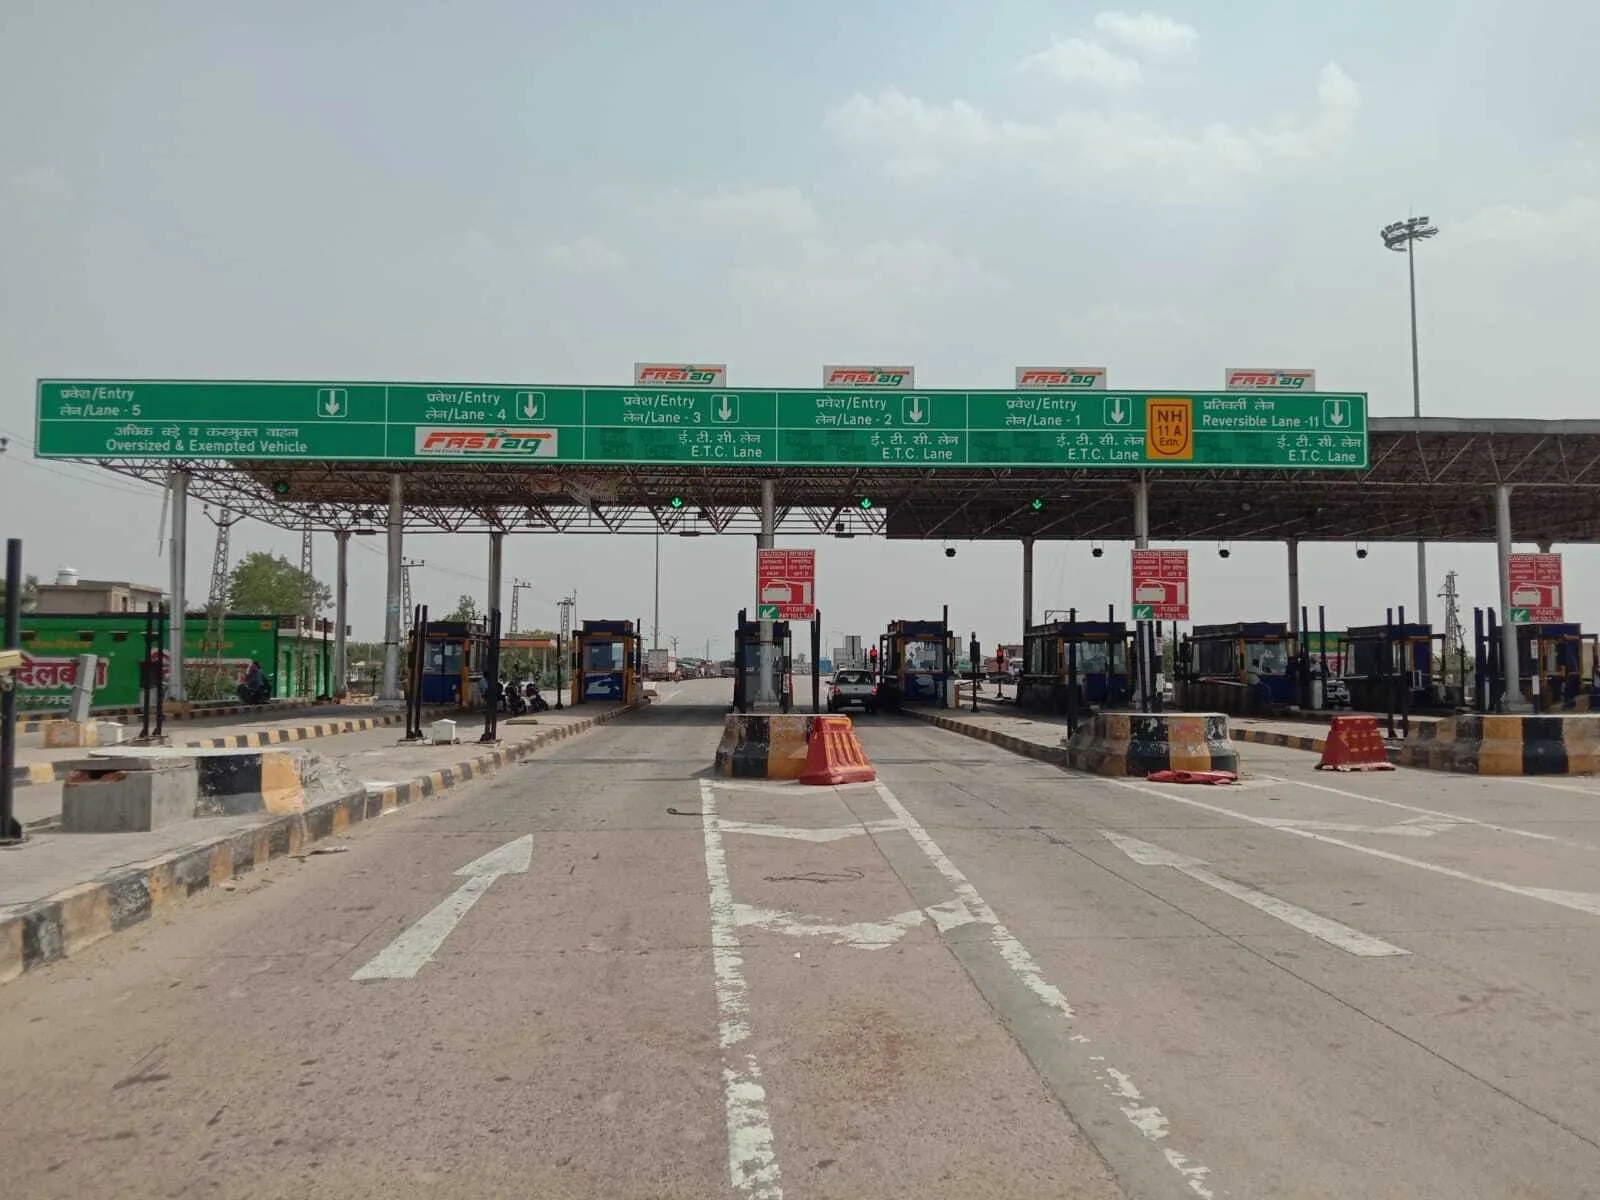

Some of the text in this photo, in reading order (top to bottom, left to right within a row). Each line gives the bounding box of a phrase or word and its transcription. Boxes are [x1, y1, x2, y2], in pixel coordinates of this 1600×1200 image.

[132, 404, 141, 416] 5
[1254, 398, 1275, 410] लेन
[497, 409, 507, 420] 4
[693, 412, 701, 423] 3
[884, 414, 892, 425] 2
[1075, 415, 1081, 426] 1
[1157, 410, 1182, 422] NH
[1202, 414, 1267, 427] Reversible
[1271, 415, 1301, 427] Lane
[423, 432, 548, 454] FASTag
[740, 430, 761, 444] लेन
[937, 432, 959, 445] लेन
[1123, 433, 1144, 446] लेन
[1341, 436, 1362, 448] लेन
[105, 438, 308, 453] Oversized & Exempted Vehicle
[691, 445, 728, 458] E.T.C.
[733, 445, 763, 458] Lane
[882, 448, 953, 460] E.T.C. Lane
[1068, 448, 1139, 461] E.T.C. Lane
[1288, 450, 1357, 462] E.T.C. Lane
